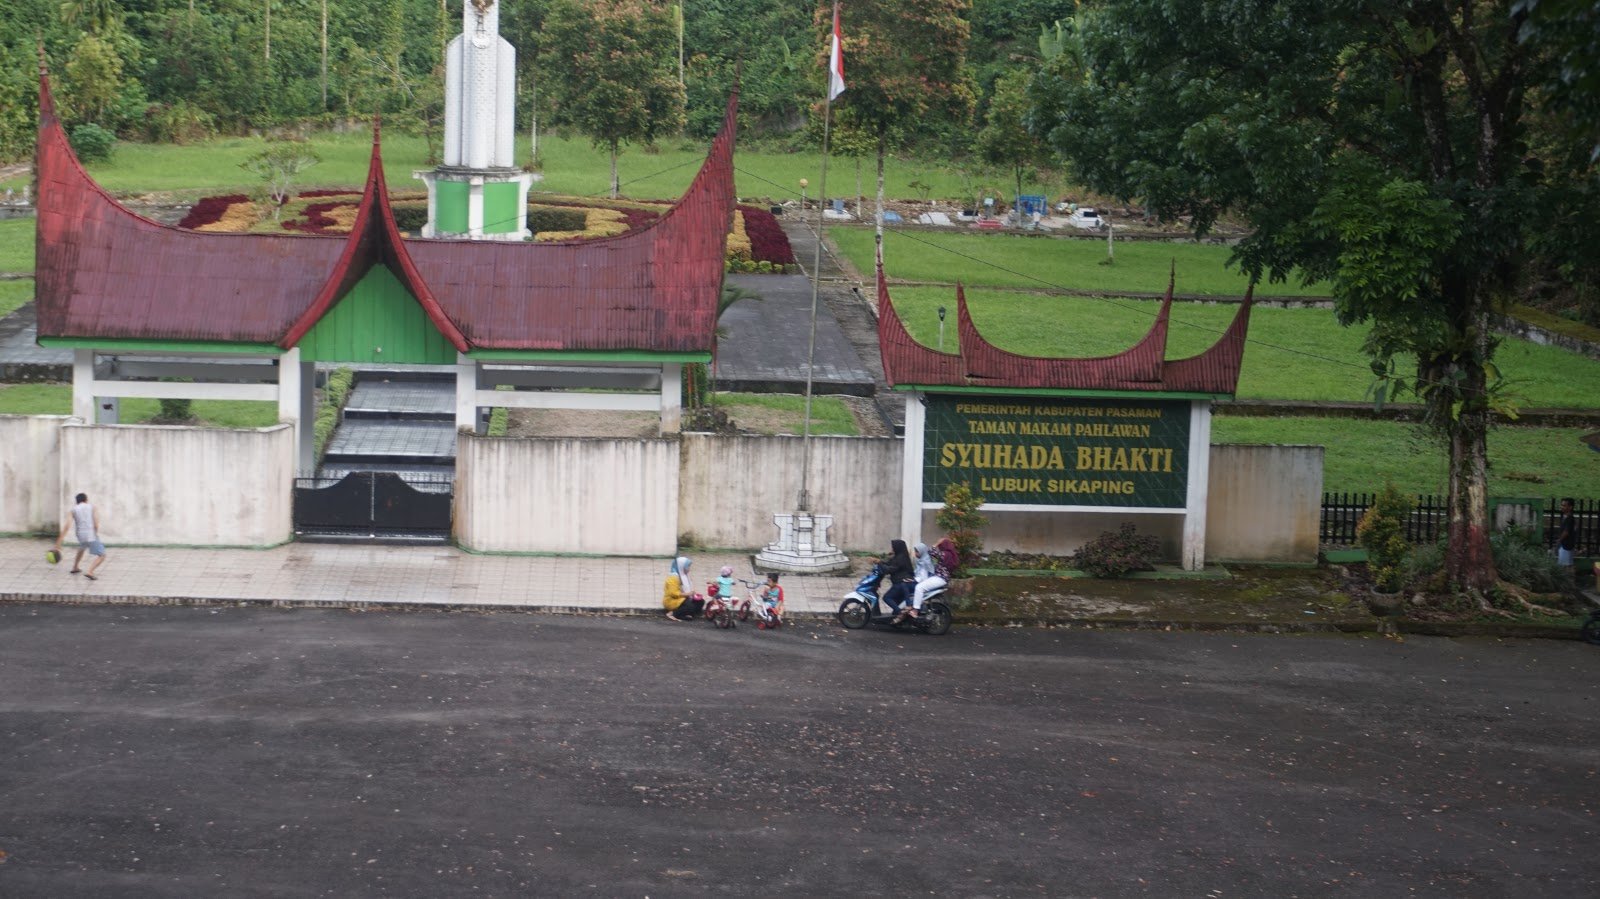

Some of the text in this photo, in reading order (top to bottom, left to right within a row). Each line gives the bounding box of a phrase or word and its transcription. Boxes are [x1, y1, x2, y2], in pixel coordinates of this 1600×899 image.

[956, 404, 1161, 418] PEMERINTAH KABUPATEN PASAMAN
[968, 420, 1151, 438] TAMAN MAKAM PAHLAWAN
[940, 443, 1173, 473] SYUHADA BHAKTI
[981, 477, 1135, 495] LUBUK SIKAPING
